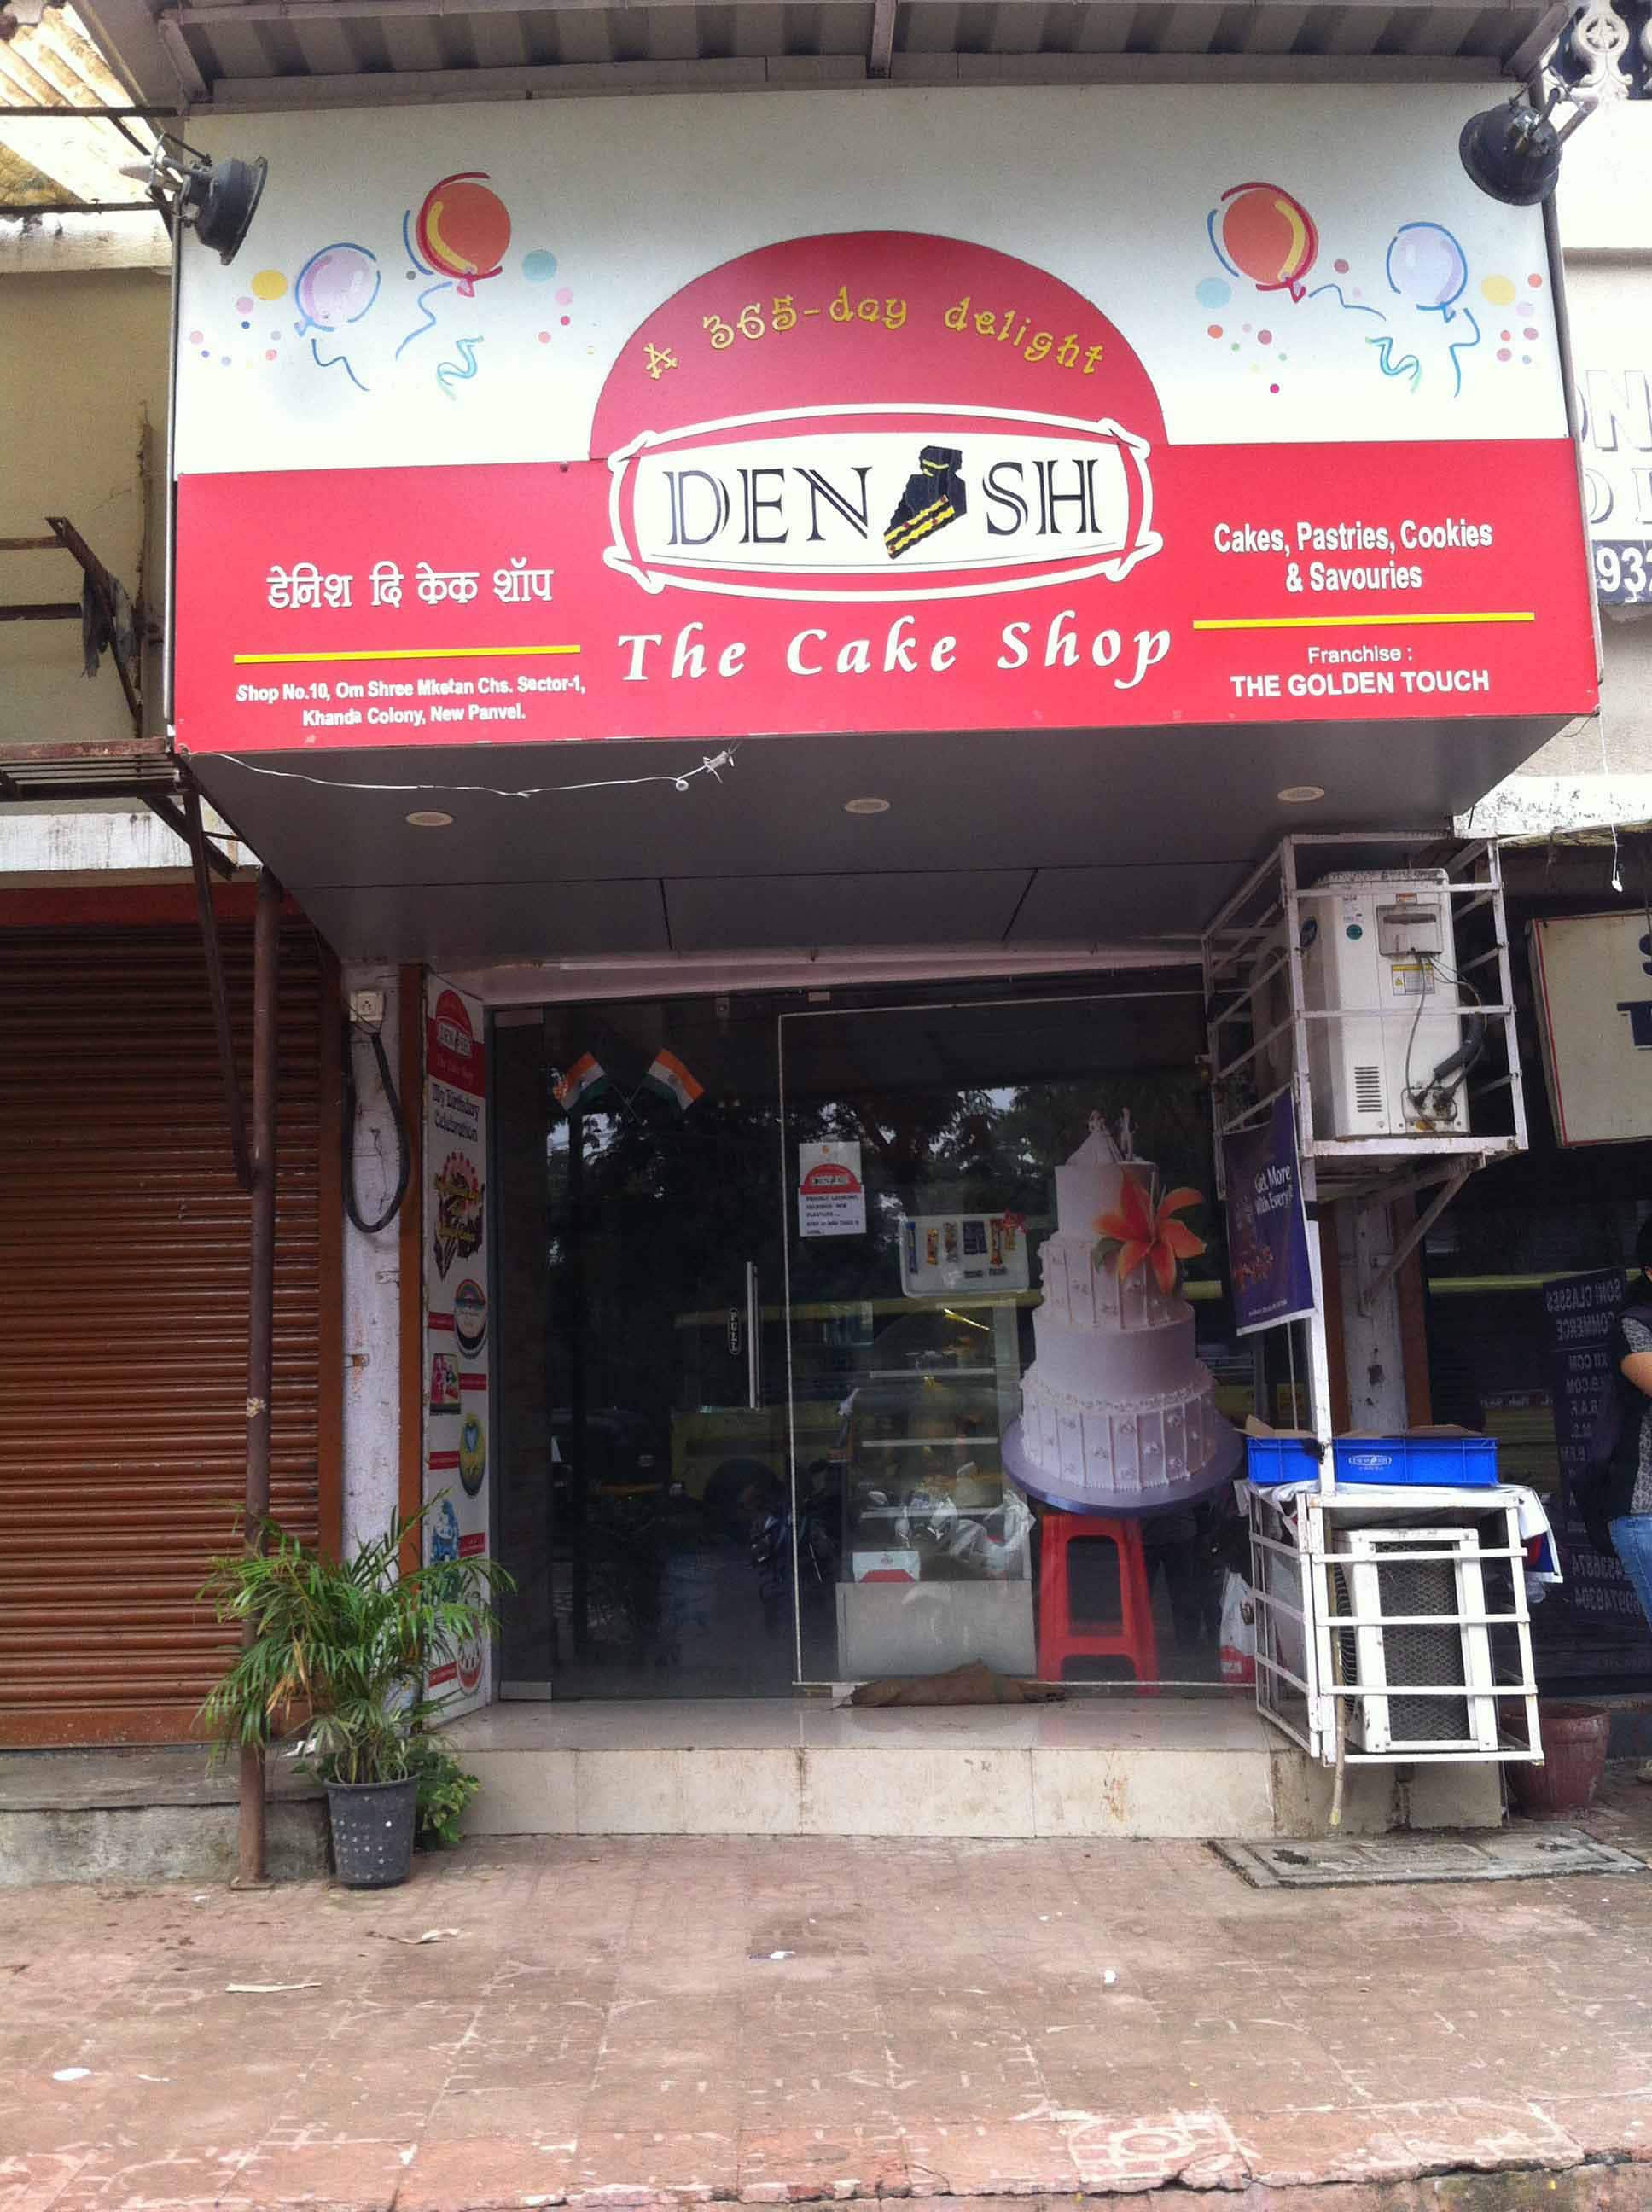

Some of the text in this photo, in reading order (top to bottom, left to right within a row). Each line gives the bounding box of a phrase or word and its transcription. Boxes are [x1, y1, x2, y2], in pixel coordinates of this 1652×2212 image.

[702, 286, 908, 349] 365-day
[944, 296, 1103, 375] delight
[1214, 518, 1493, 556] Cakes, Pastries, Cookies
[266, 557, 554, 608] डेनिश दि केक शॉप
[1285, 560, 1422, 592] & Savouries
[619, 609, 1172, 690] The Cake Shop
[1307, 644, 1401, 665] Franchise
[236, 684, 279, 704] Shop
[282, 683, 330, 701] No.10,
[336, 682, 364, 699] Om
[368, 679, 413, 697] Shree
[478, 676, 513, 695] Chs.
[1230, 669, 1490, 698] THE GOLDEN TOUCH
[302, 703, 526, 727] Khanda Colony, New Panvel.
